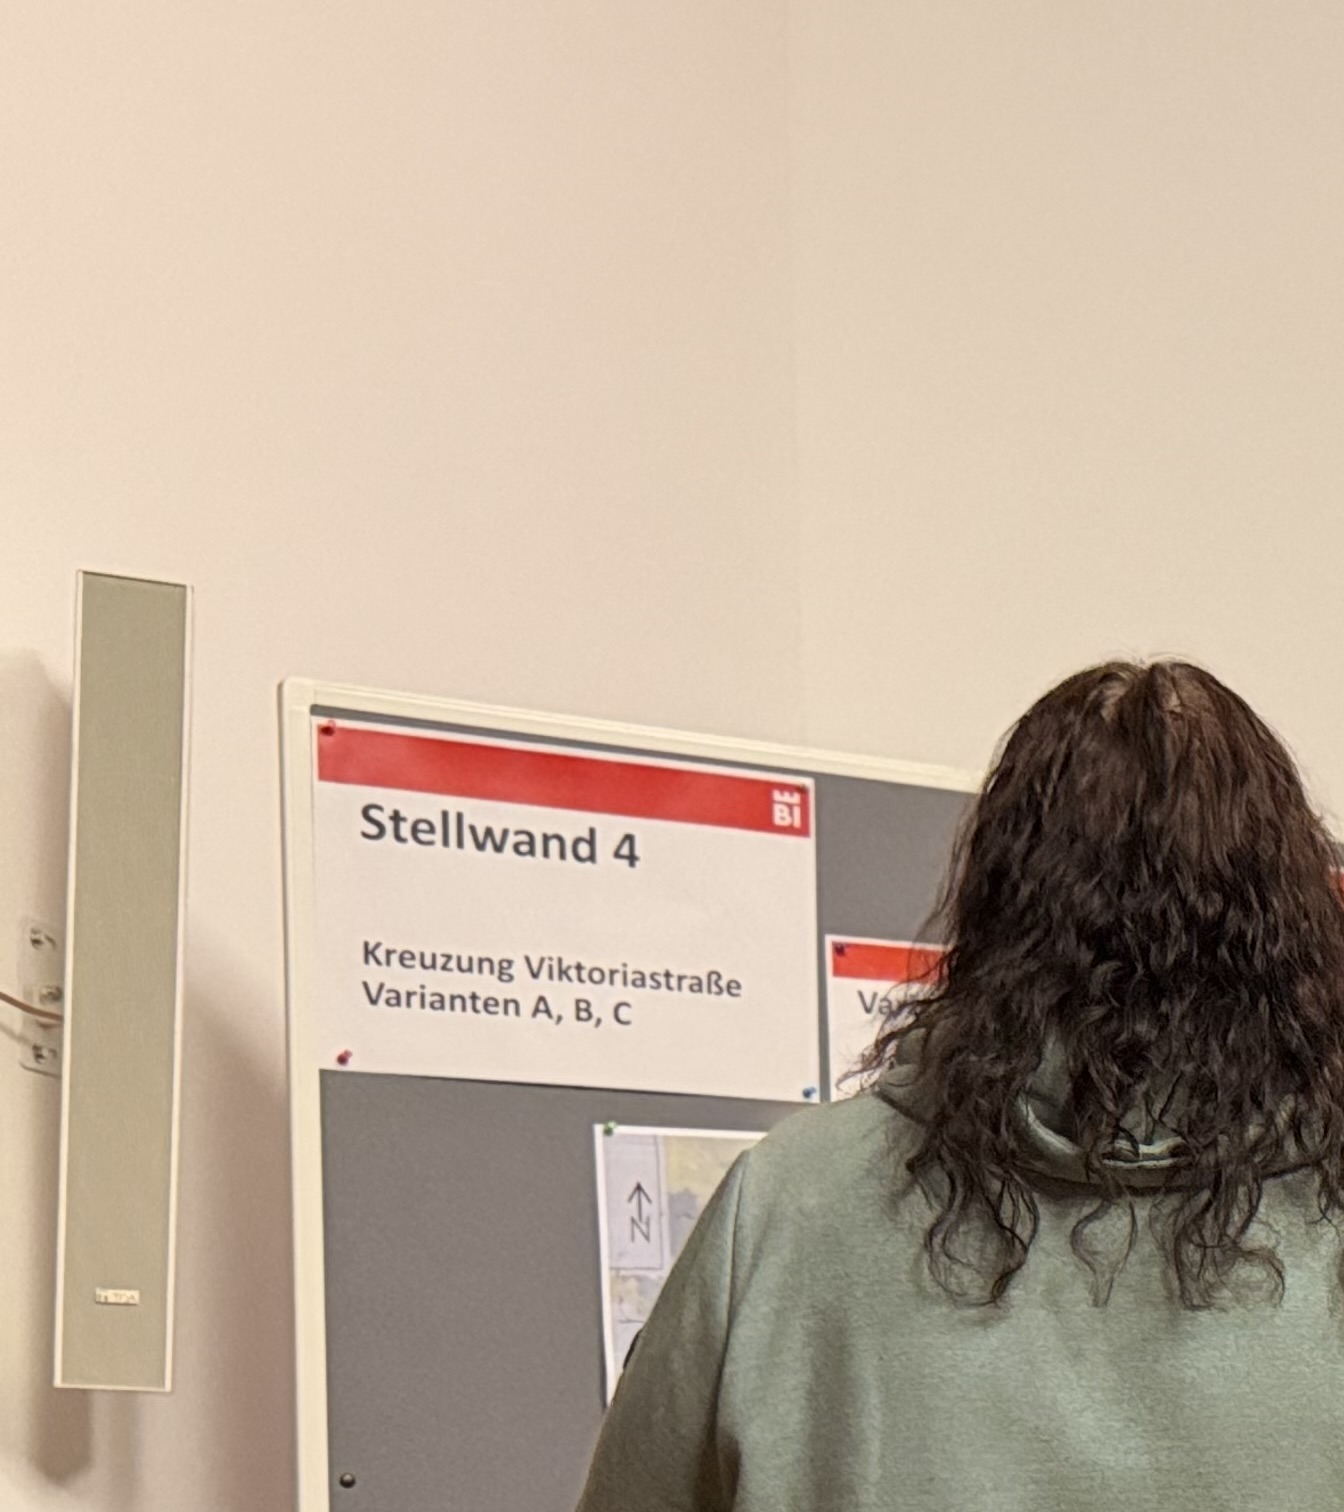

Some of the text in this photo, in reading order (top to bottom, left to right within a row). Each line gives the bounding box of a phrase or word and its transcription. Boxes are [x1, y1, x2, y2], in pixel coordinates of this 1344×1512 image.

[360, 803, 641, 869] Stellwand 4
[362, 941, 743, 998] Kreuzung Viktoriastraße
[362, 980, 633, 1029] Varianten A, B, C
[857, 989, 893, 1015] Va
